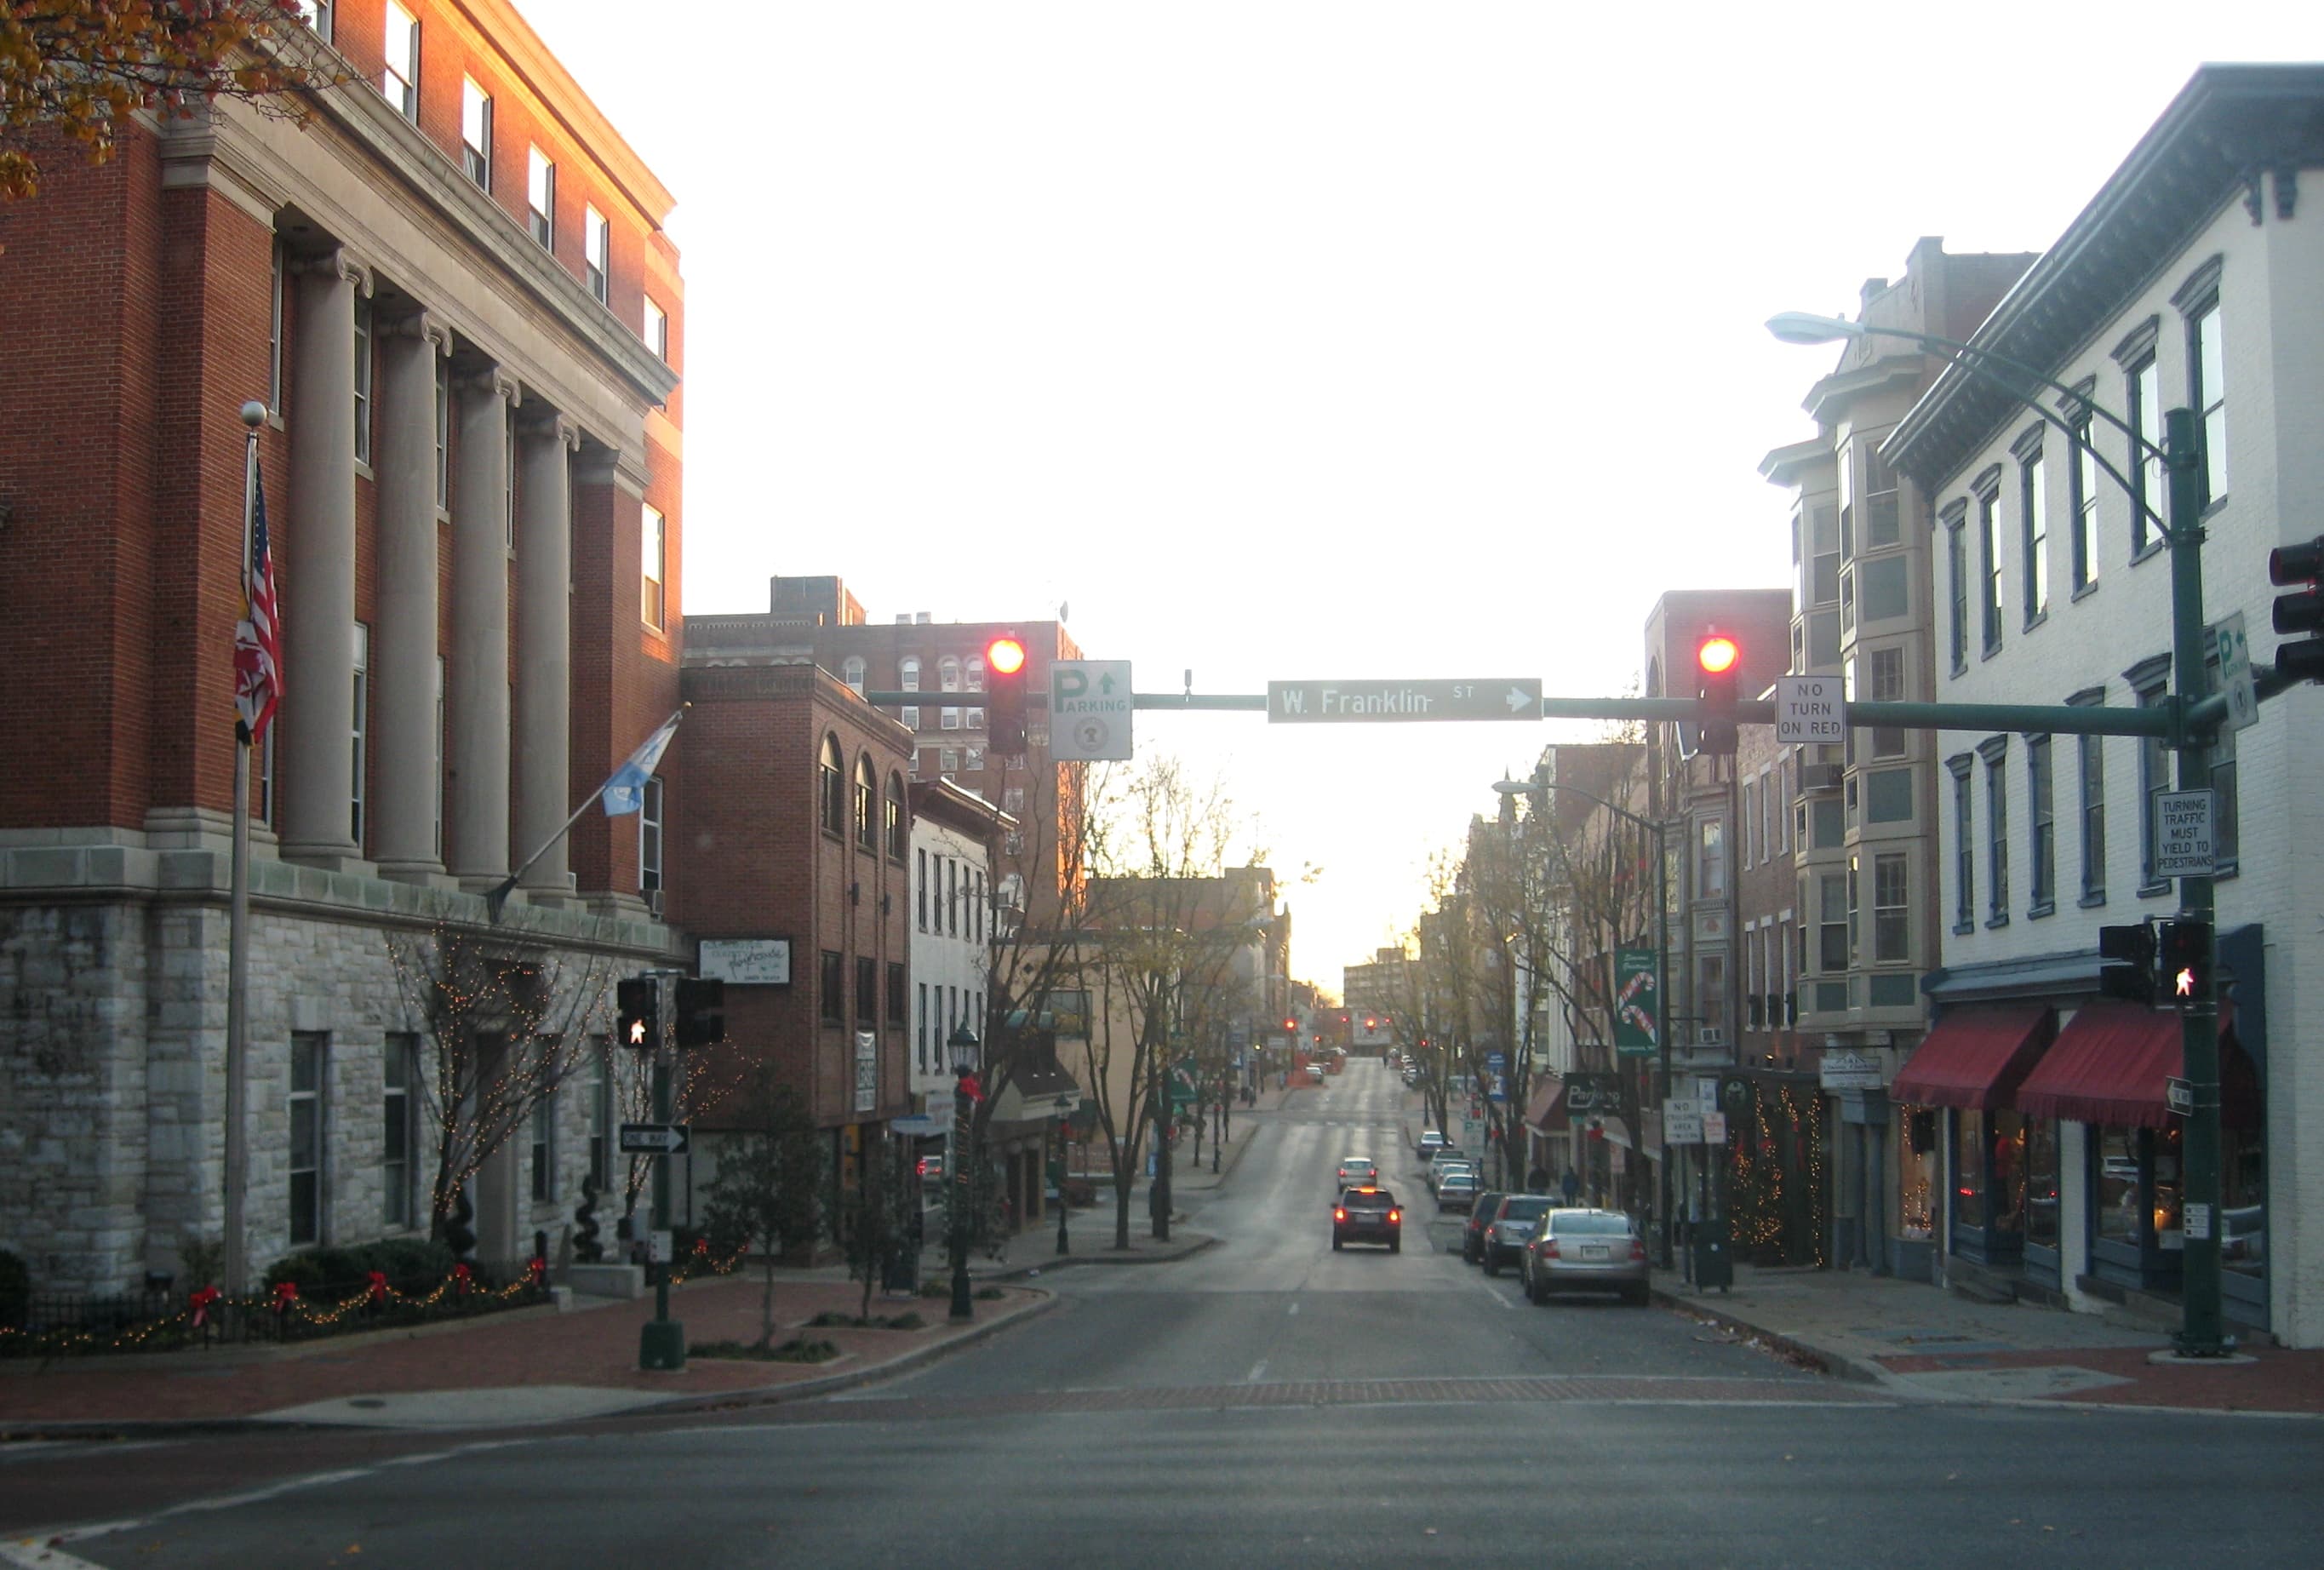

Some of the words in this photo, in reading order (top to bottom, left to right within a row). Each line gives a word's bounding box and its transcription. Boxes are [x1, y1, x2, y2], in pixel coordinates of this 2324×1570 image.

[1054, 669, 1125, 713] PARKING
[1798, 684, 1823, 696] NO
[1322, 689, 1429, 713] Franklin
[1454, 685, 1474, 699] ST
[1790, 702, 1831, 715] TURN
[1781, 721, 1800, 734] ON
[1811, 721, 1840, 734] RED
[2163, 799, 2206, 813] TURNING
[2165, 811, 2205, 825] TRAFFIC
[2171, 827, 2199, 839] MUST
[2162, 842, 2191, 854] YIELD
[2197, 841, 2208, 852] TO
[2158, 855, 2212, 868] PEDESTRIANS
[1674, 1103, 1689, 1111] NO
